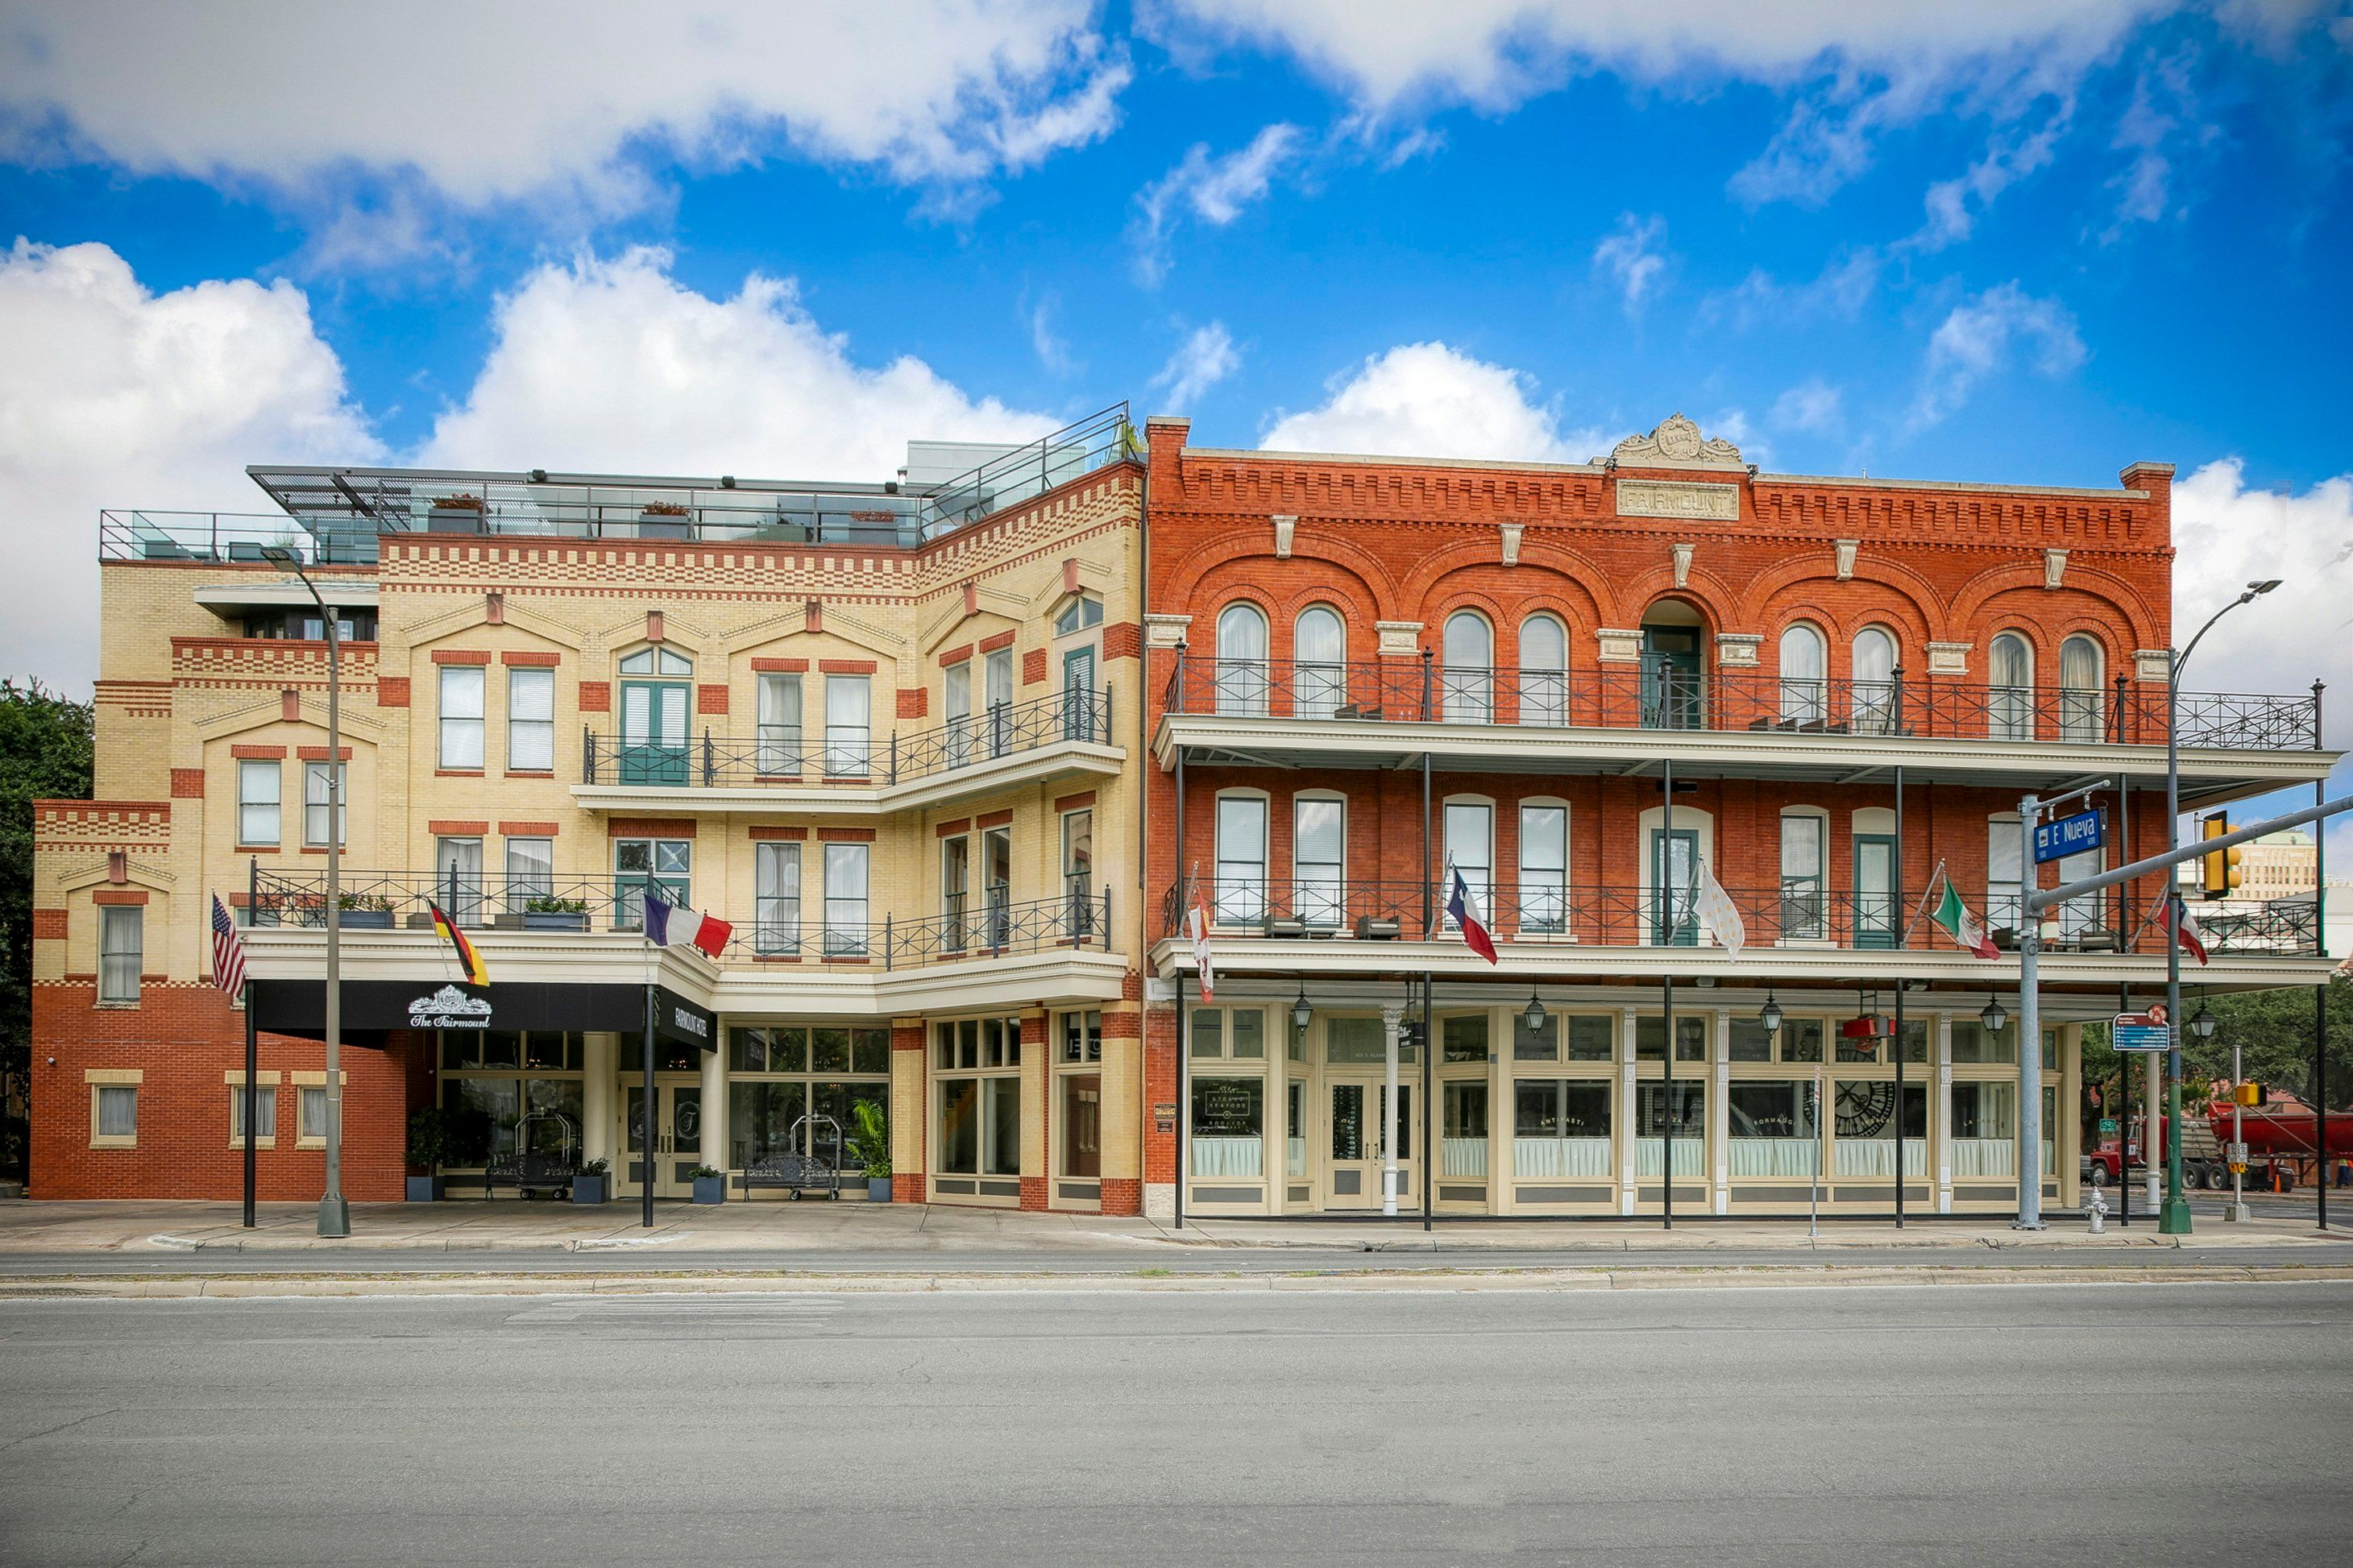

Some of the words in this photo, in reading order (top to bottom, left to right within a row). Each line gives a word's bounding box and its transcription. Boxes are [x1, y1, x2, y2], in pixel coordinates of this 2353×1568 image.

[1623, 491, 1728, 512] FAIRMOUNT
[2053, 825, 2059, 845] E
[2065, 818, 2094, 842] Nueva
[410, 1014, 432, 1027] The
[434, 1014, 490, 1027] Fairmount
[675, 1007, 696, 1033] FAIRMOUNT
[697, 1017, 707, 1037] HOTEL
[1541, 1117, 1584, 1126] ANTIPASTI
